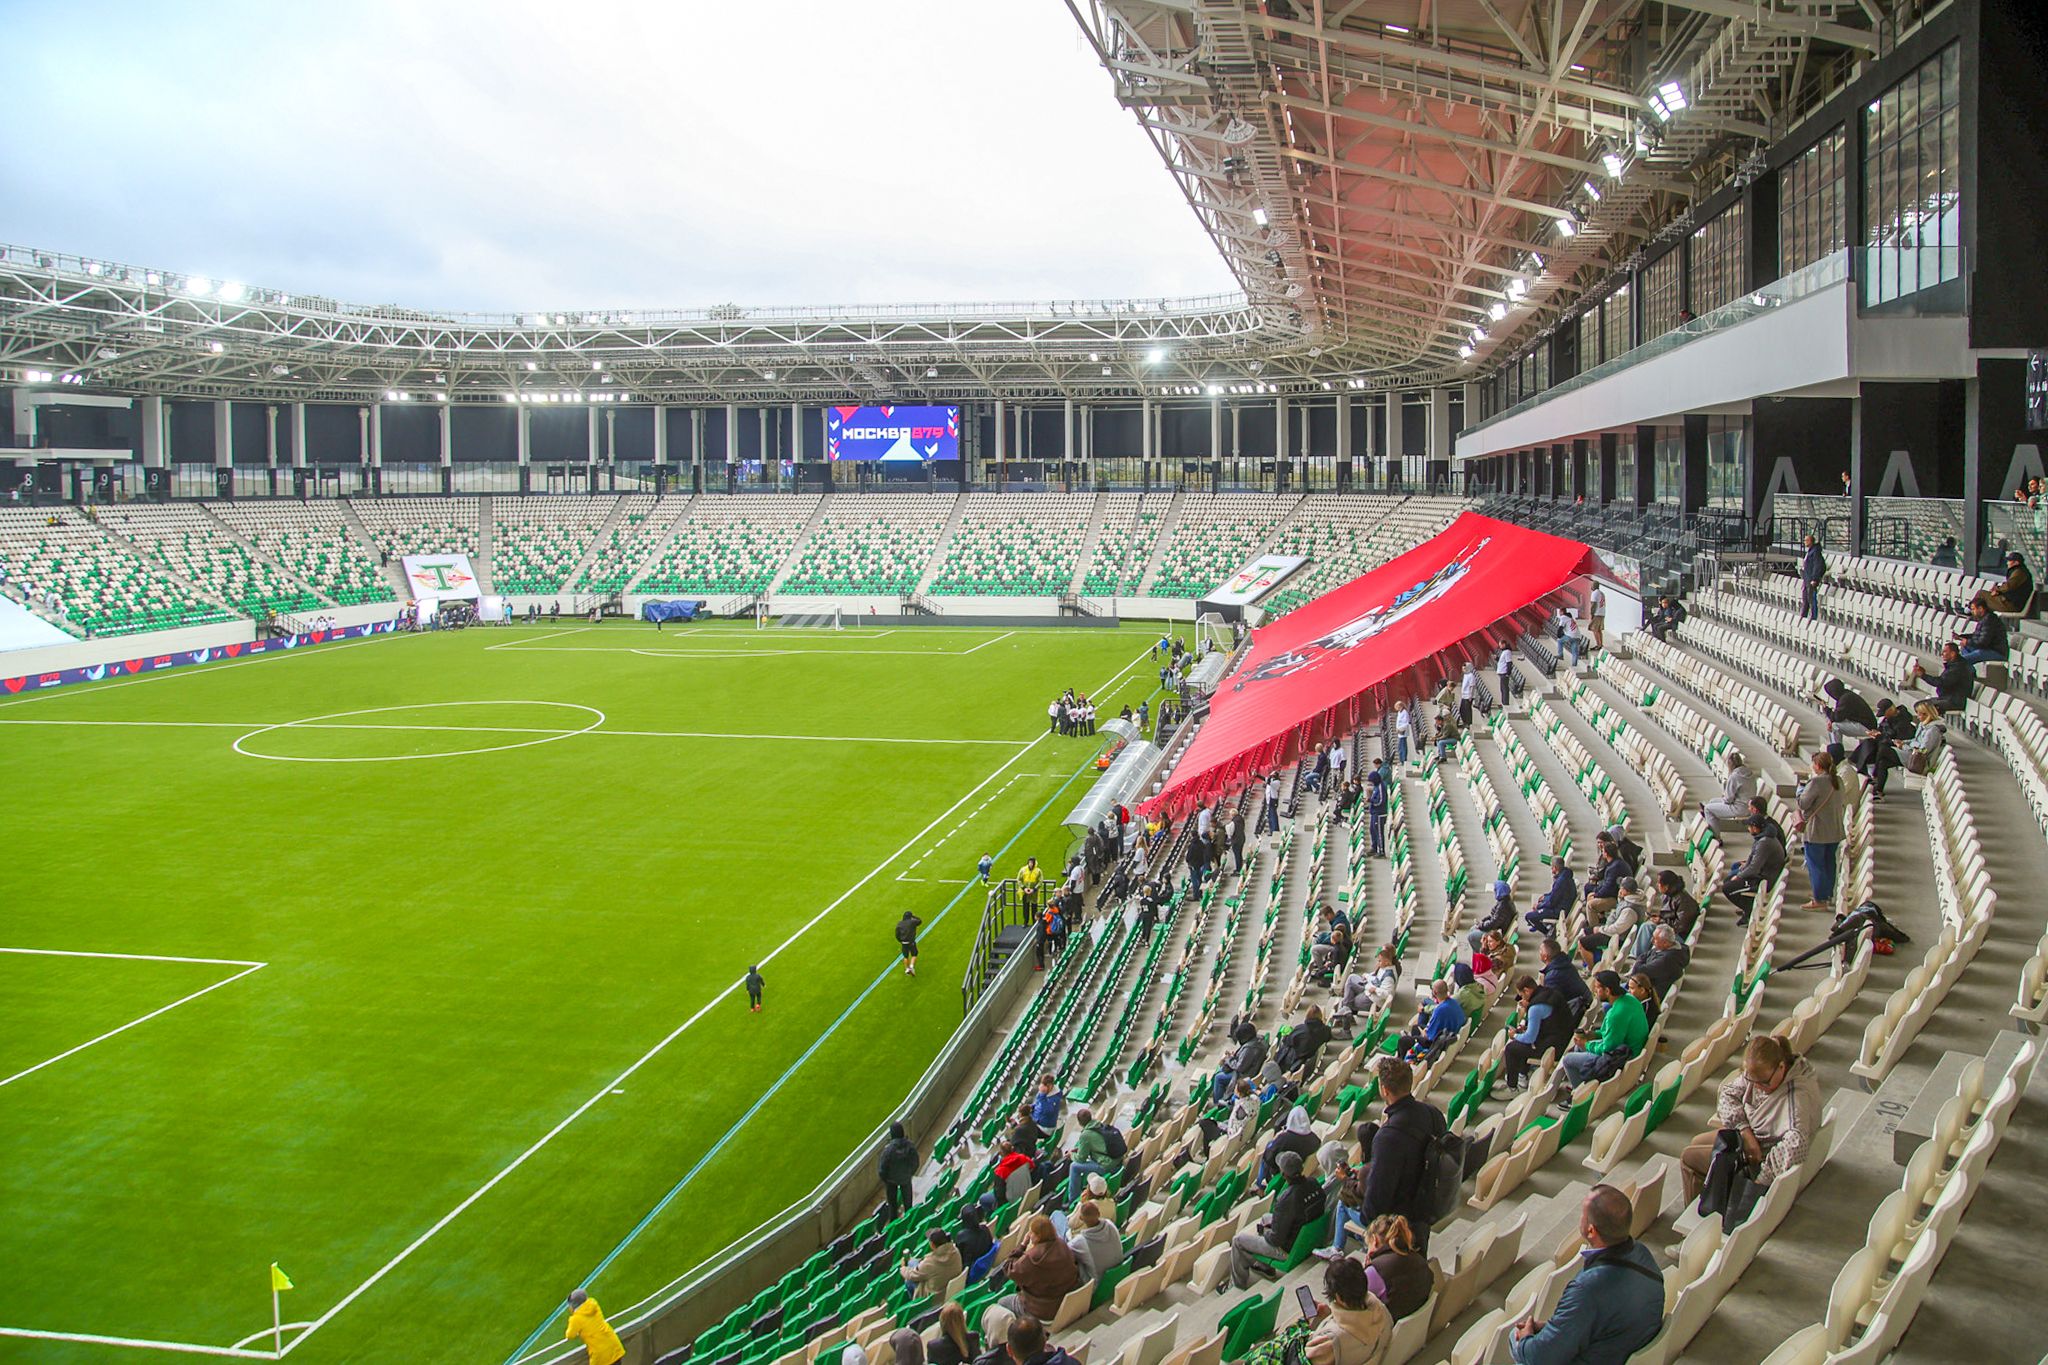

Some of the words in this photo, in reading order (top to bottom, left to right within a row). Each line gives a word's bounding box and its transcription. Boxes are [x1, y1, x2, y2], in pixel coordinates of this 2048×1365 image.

[25, 473, 33, 487] 8
[101, 473, 109, 486] 9
[151, 473, 159, 485] 9
[218, 473, 229, 485] 10
[1876, 1101, 1909, 1119] 19
